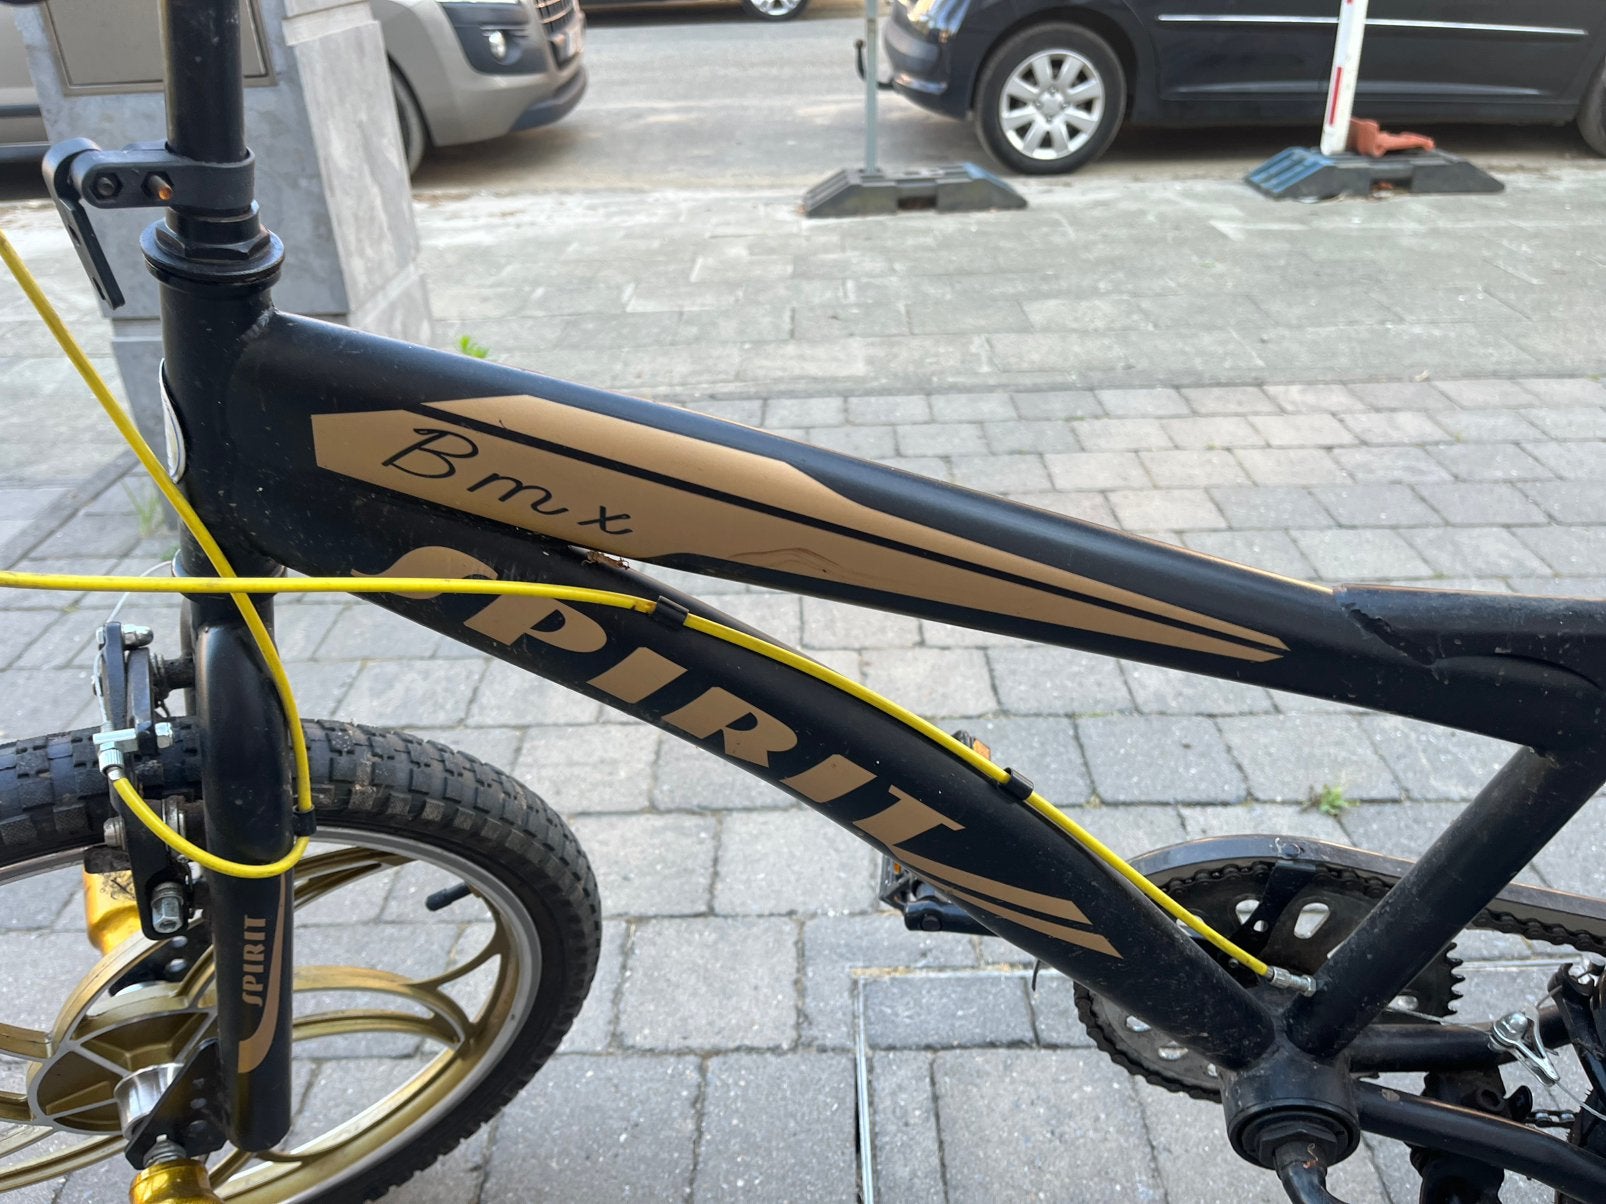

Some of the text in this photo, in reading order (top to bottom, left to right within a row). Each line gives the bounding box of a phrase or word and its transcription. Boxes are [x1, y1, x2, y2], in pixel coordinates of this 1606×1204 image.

[381, 427, 633, 536] Bmx
[351, 545, 966, 848] SPIRIT
[241, 914, 267, 1008] SPIRIT
